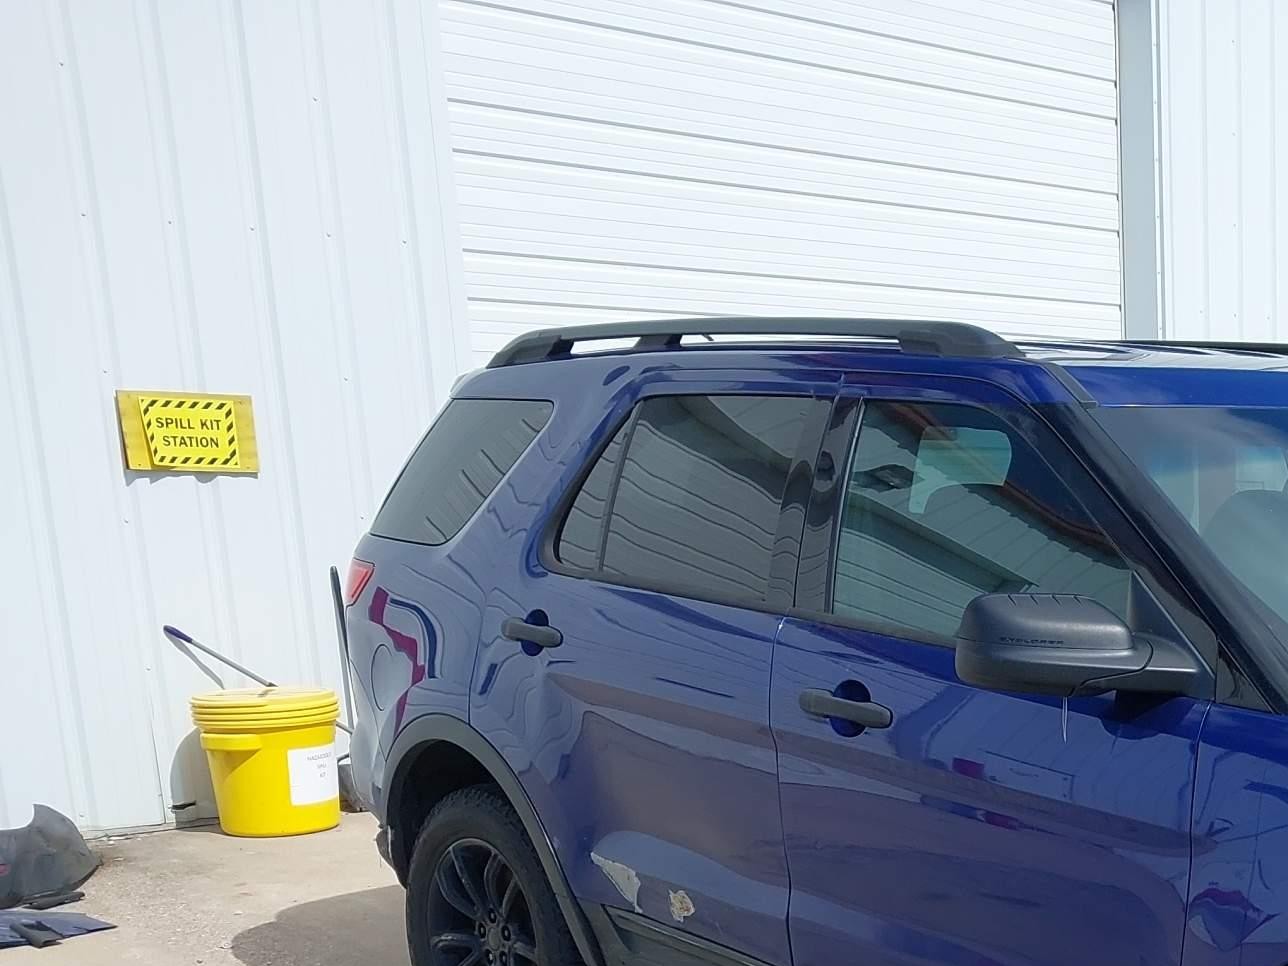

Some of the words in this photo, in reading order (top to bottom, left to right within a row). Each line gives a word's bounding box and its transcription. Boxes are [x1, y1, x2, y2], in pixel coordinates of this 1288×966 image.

[155, 417, 195, 430] SPILL
[200, 418, 222, 431] KIT
[162, 435, 220, 448] STATION
